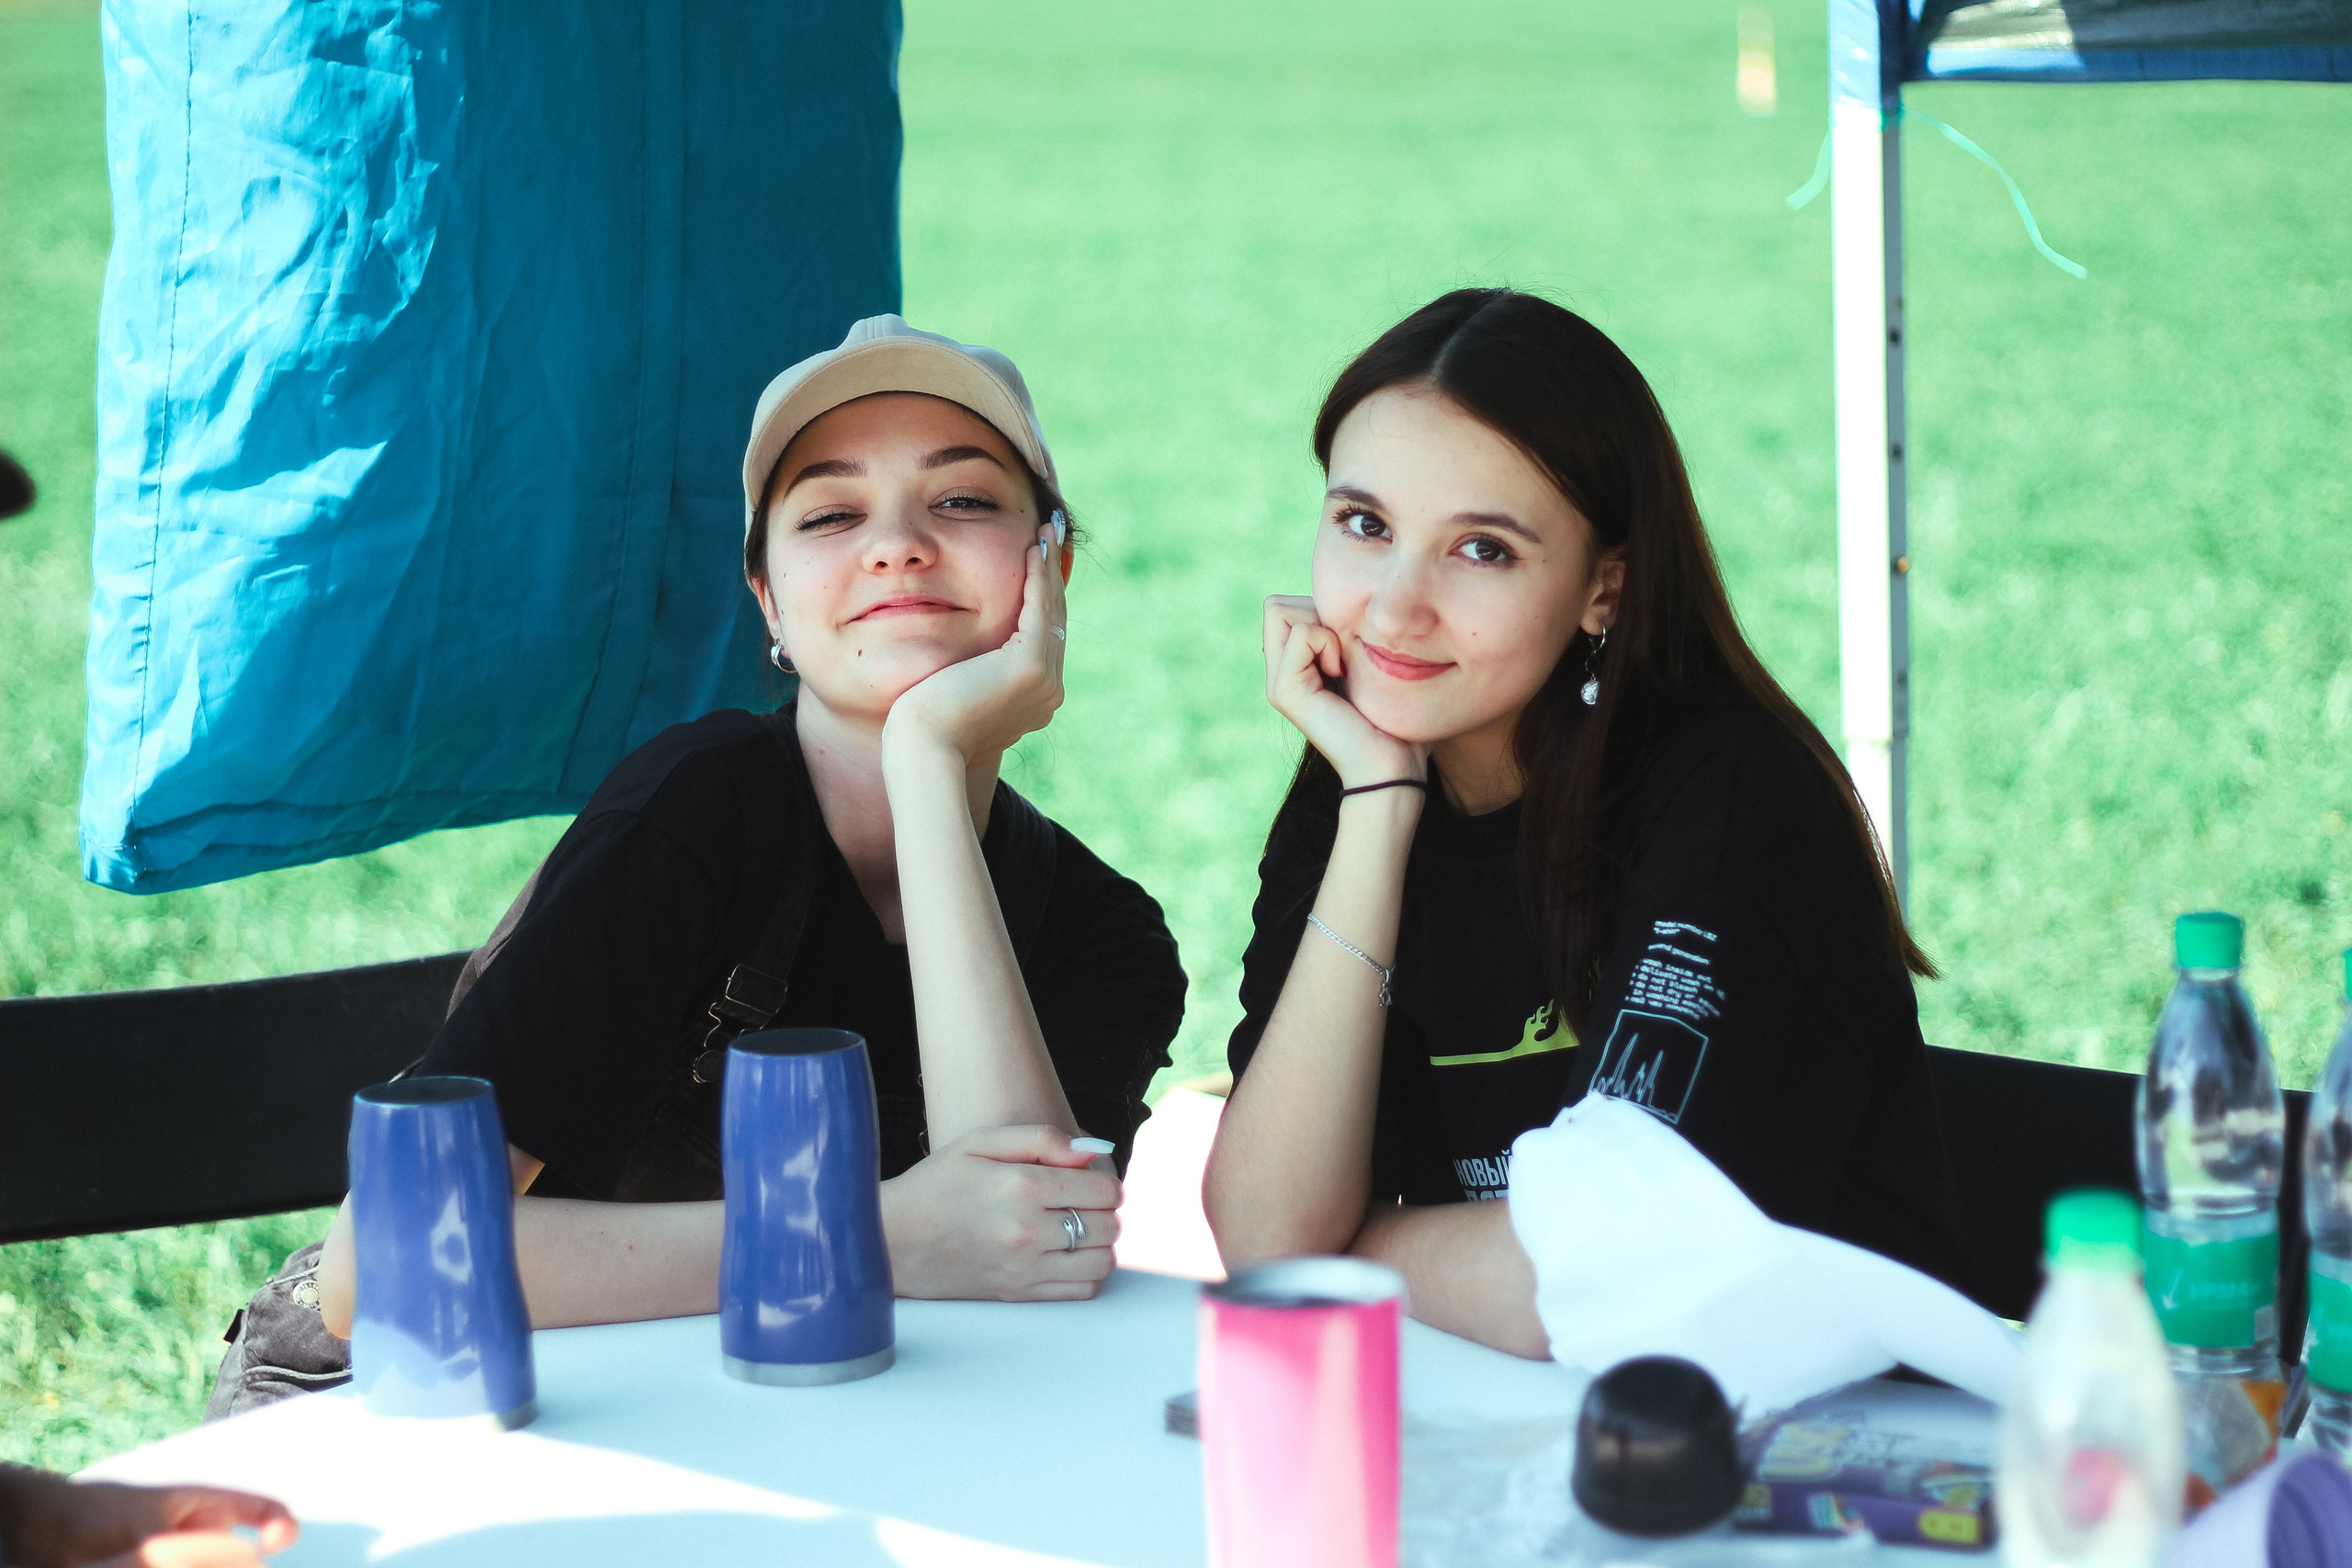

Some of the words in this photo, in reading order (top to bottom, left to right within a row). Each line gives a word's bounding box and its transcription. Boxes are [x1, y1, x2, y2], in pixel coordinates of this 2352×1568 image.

[1677, 922, 1702, 935] number
[1642, 958, 1663, 968] wash
[1665, 964, 1693, 977] inside
[1697, 975, 1712, 983] out
[1637, 973, 1648, 981] do
[1651, 977, 1666, 986] not
[1668, 980, 1698, 993] bleach
[1680, 977, 1701, 987] wash
[1633, 987, 1644, 996] in
[1667, 988, 1682, 998] dry
[1453, 1149, 1512, 1186] НОВЫЙ
